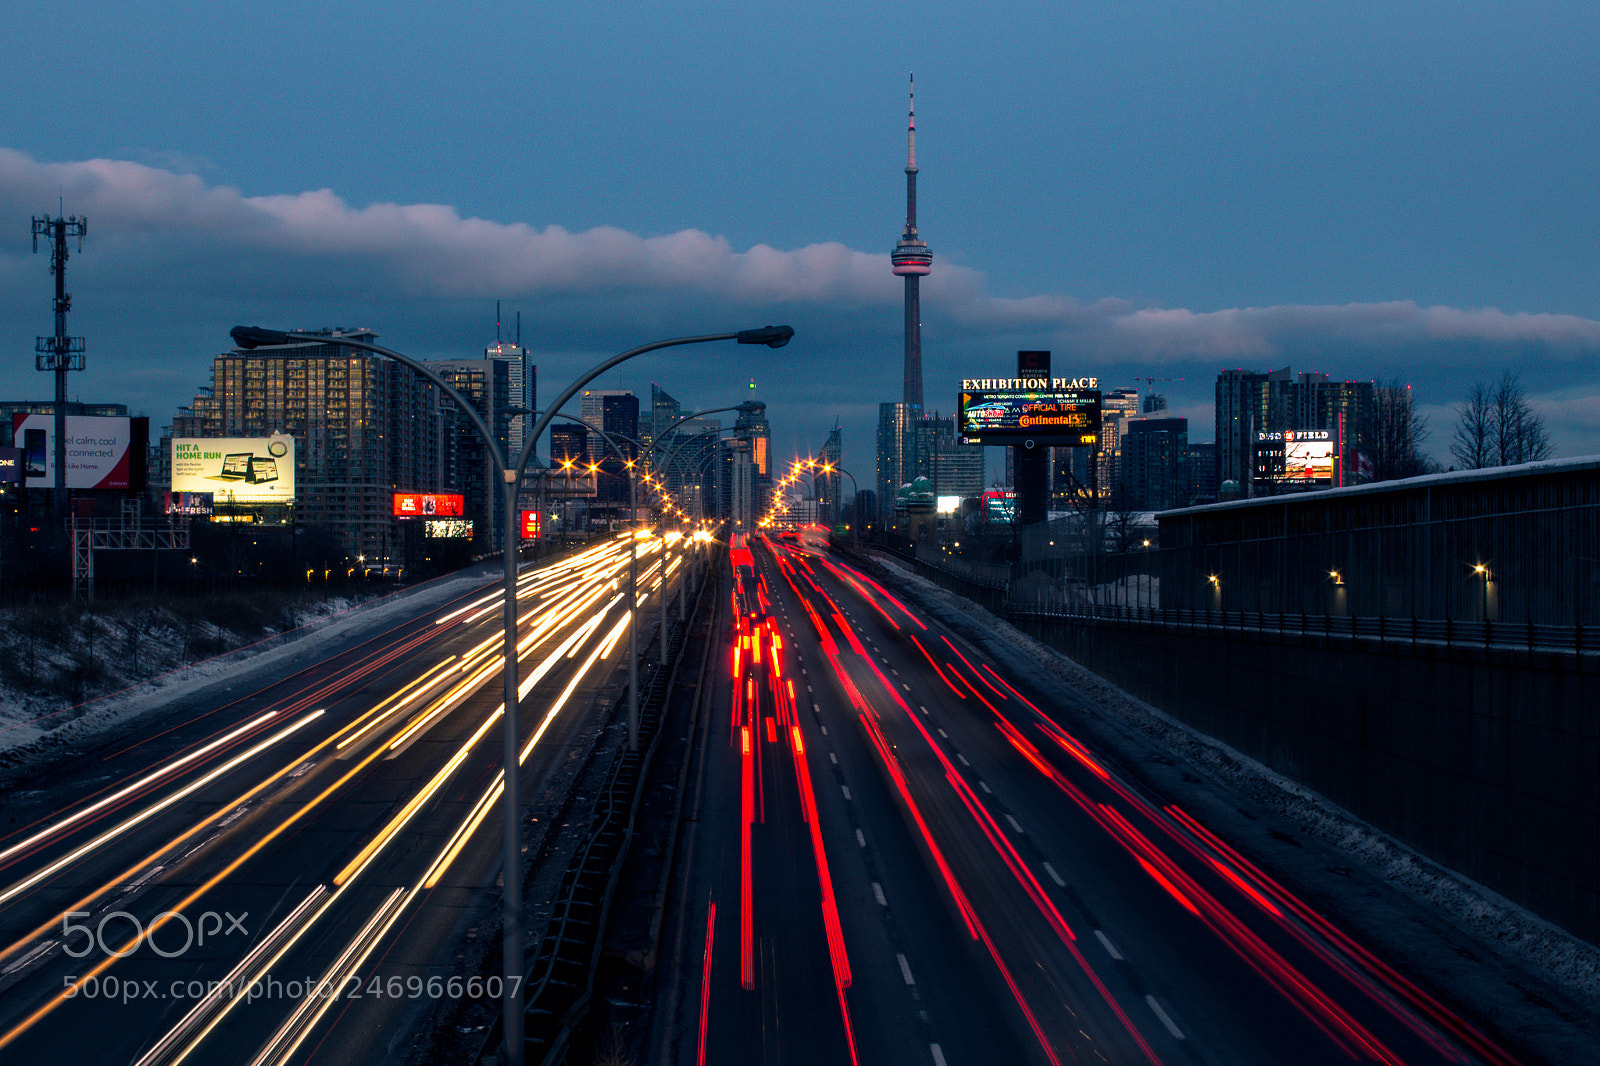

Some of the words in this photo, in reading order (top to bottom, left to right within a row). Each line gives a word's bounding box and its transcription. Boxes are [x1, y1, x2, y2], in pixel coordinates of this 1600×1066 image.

[962, 378, 1048, 390] EXHIBITION
[1052, 377, 1098, 389] PLACE
[1022, 404, 1058, 412] OFFICIAL
[1019, 415, 1072, 428] Continental
[1296, 431, 1329, 440] FIELD
[98, 437, 116, 446] cool
[176, 443, 192, 452] HIT
[193, 443, 200, 452] A
[176, 452, 202, 460] HOME
[204, 452, 222, 460] RUN
[184, 507, 213, 515] FRESH
